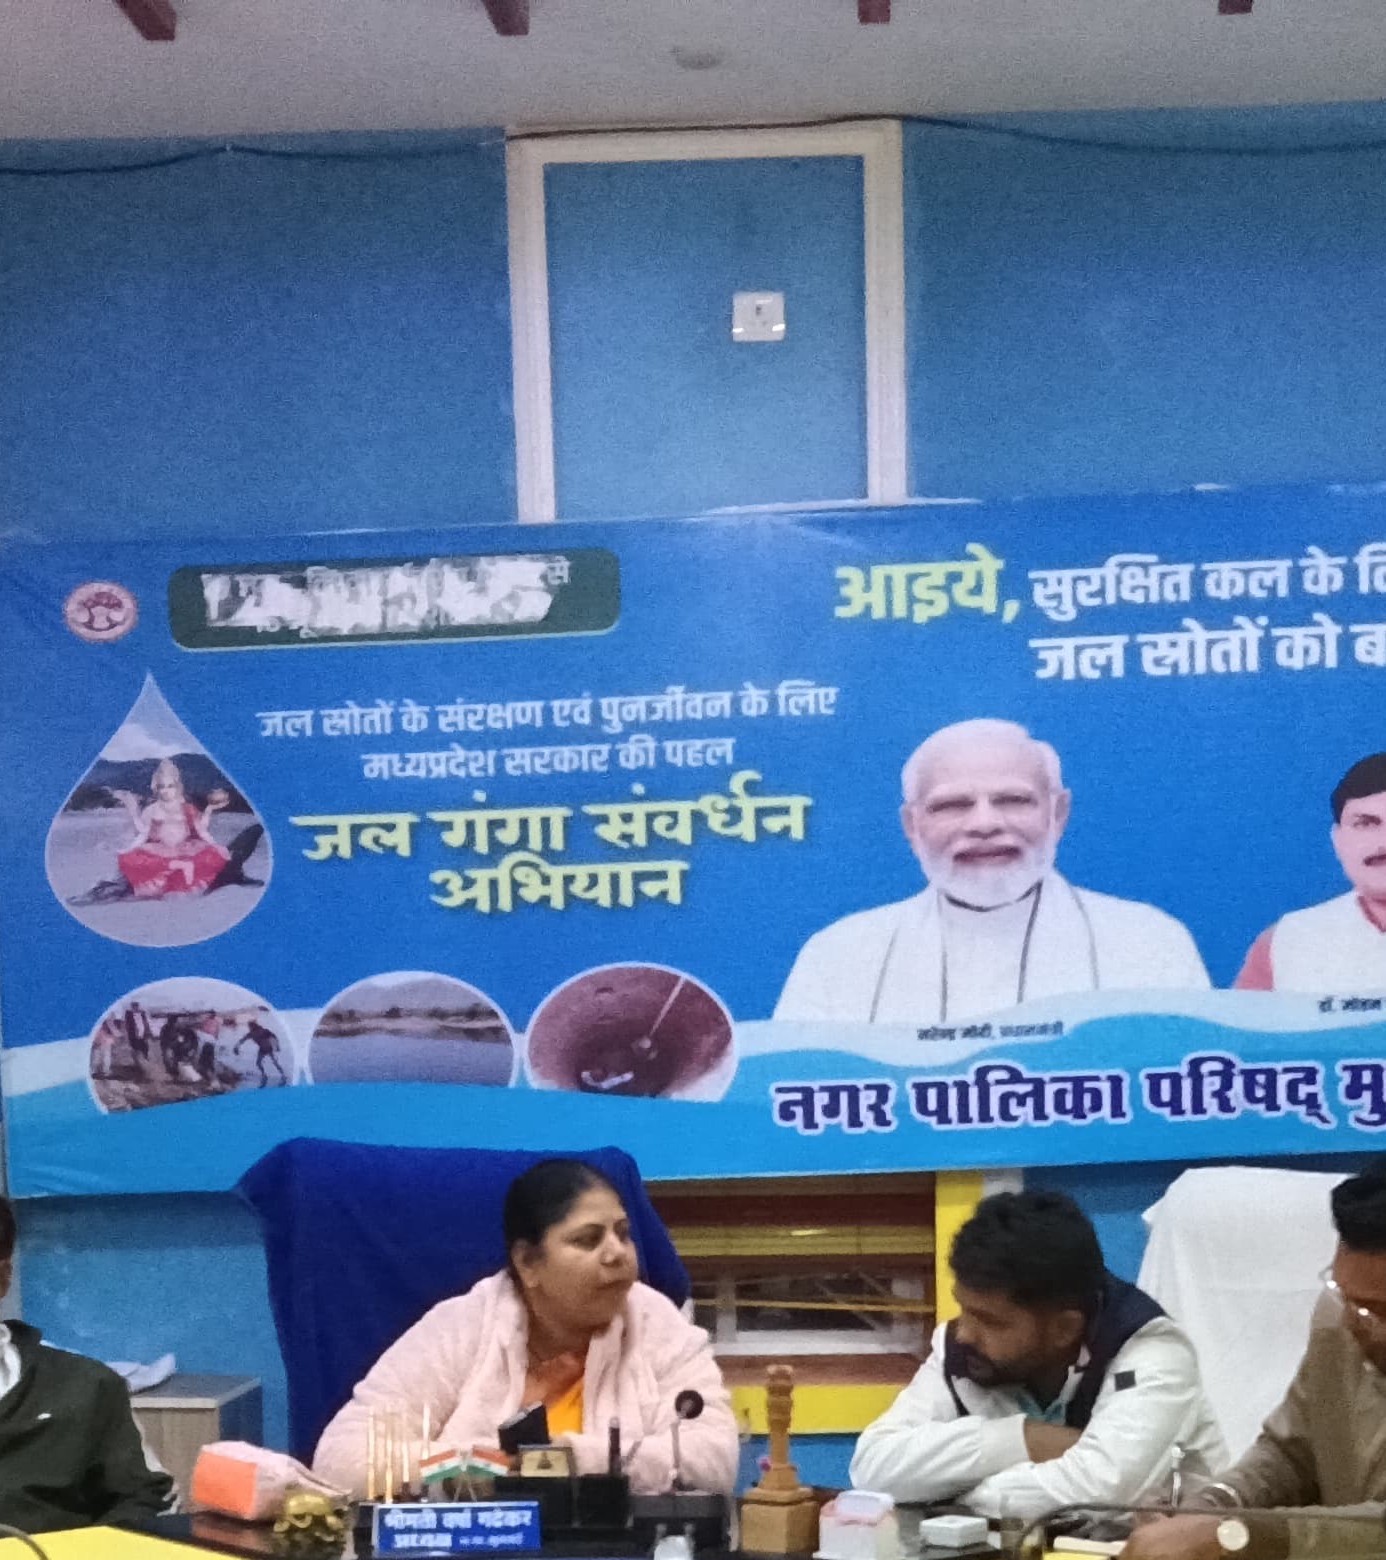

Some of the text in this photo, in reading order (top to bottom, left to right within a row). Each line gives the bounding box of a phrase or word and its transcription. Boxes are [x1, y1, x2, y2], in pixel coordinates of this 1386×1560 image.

[834, 542, 1021, 624] आइये,
[1027, 553, 1196, 622] सुरक्षित
[1201, 559, 1293, 600] कल
[1298, 545, 1348, 596] के
[1028, 634, 1130, 681] जल
[1270, 612, 1343, 671] को
[255, 709, 314, 738] जल
[398, 698, 431, 734] के
[434, 697, 545, 733] संरक्षण
[550, 691, 593, 728] एवं
[599, 684, 734, 735] पुनर्जीवन
[736, 681, 771, 718] के
[774, 679, 841, 716] लिए
[361, 733, 737, 780] मध्यप्रदेश सरकार की पहल
[289, 770, 814, 861] जल गंगा संवर्धन
[428, 850, 690, 914] अभियान
[773, 1081, 894, 1132] नगर
[910, 1062, 1129, 1127] पालिका
[1143, 1054, 1333, 1126] परिषद्
